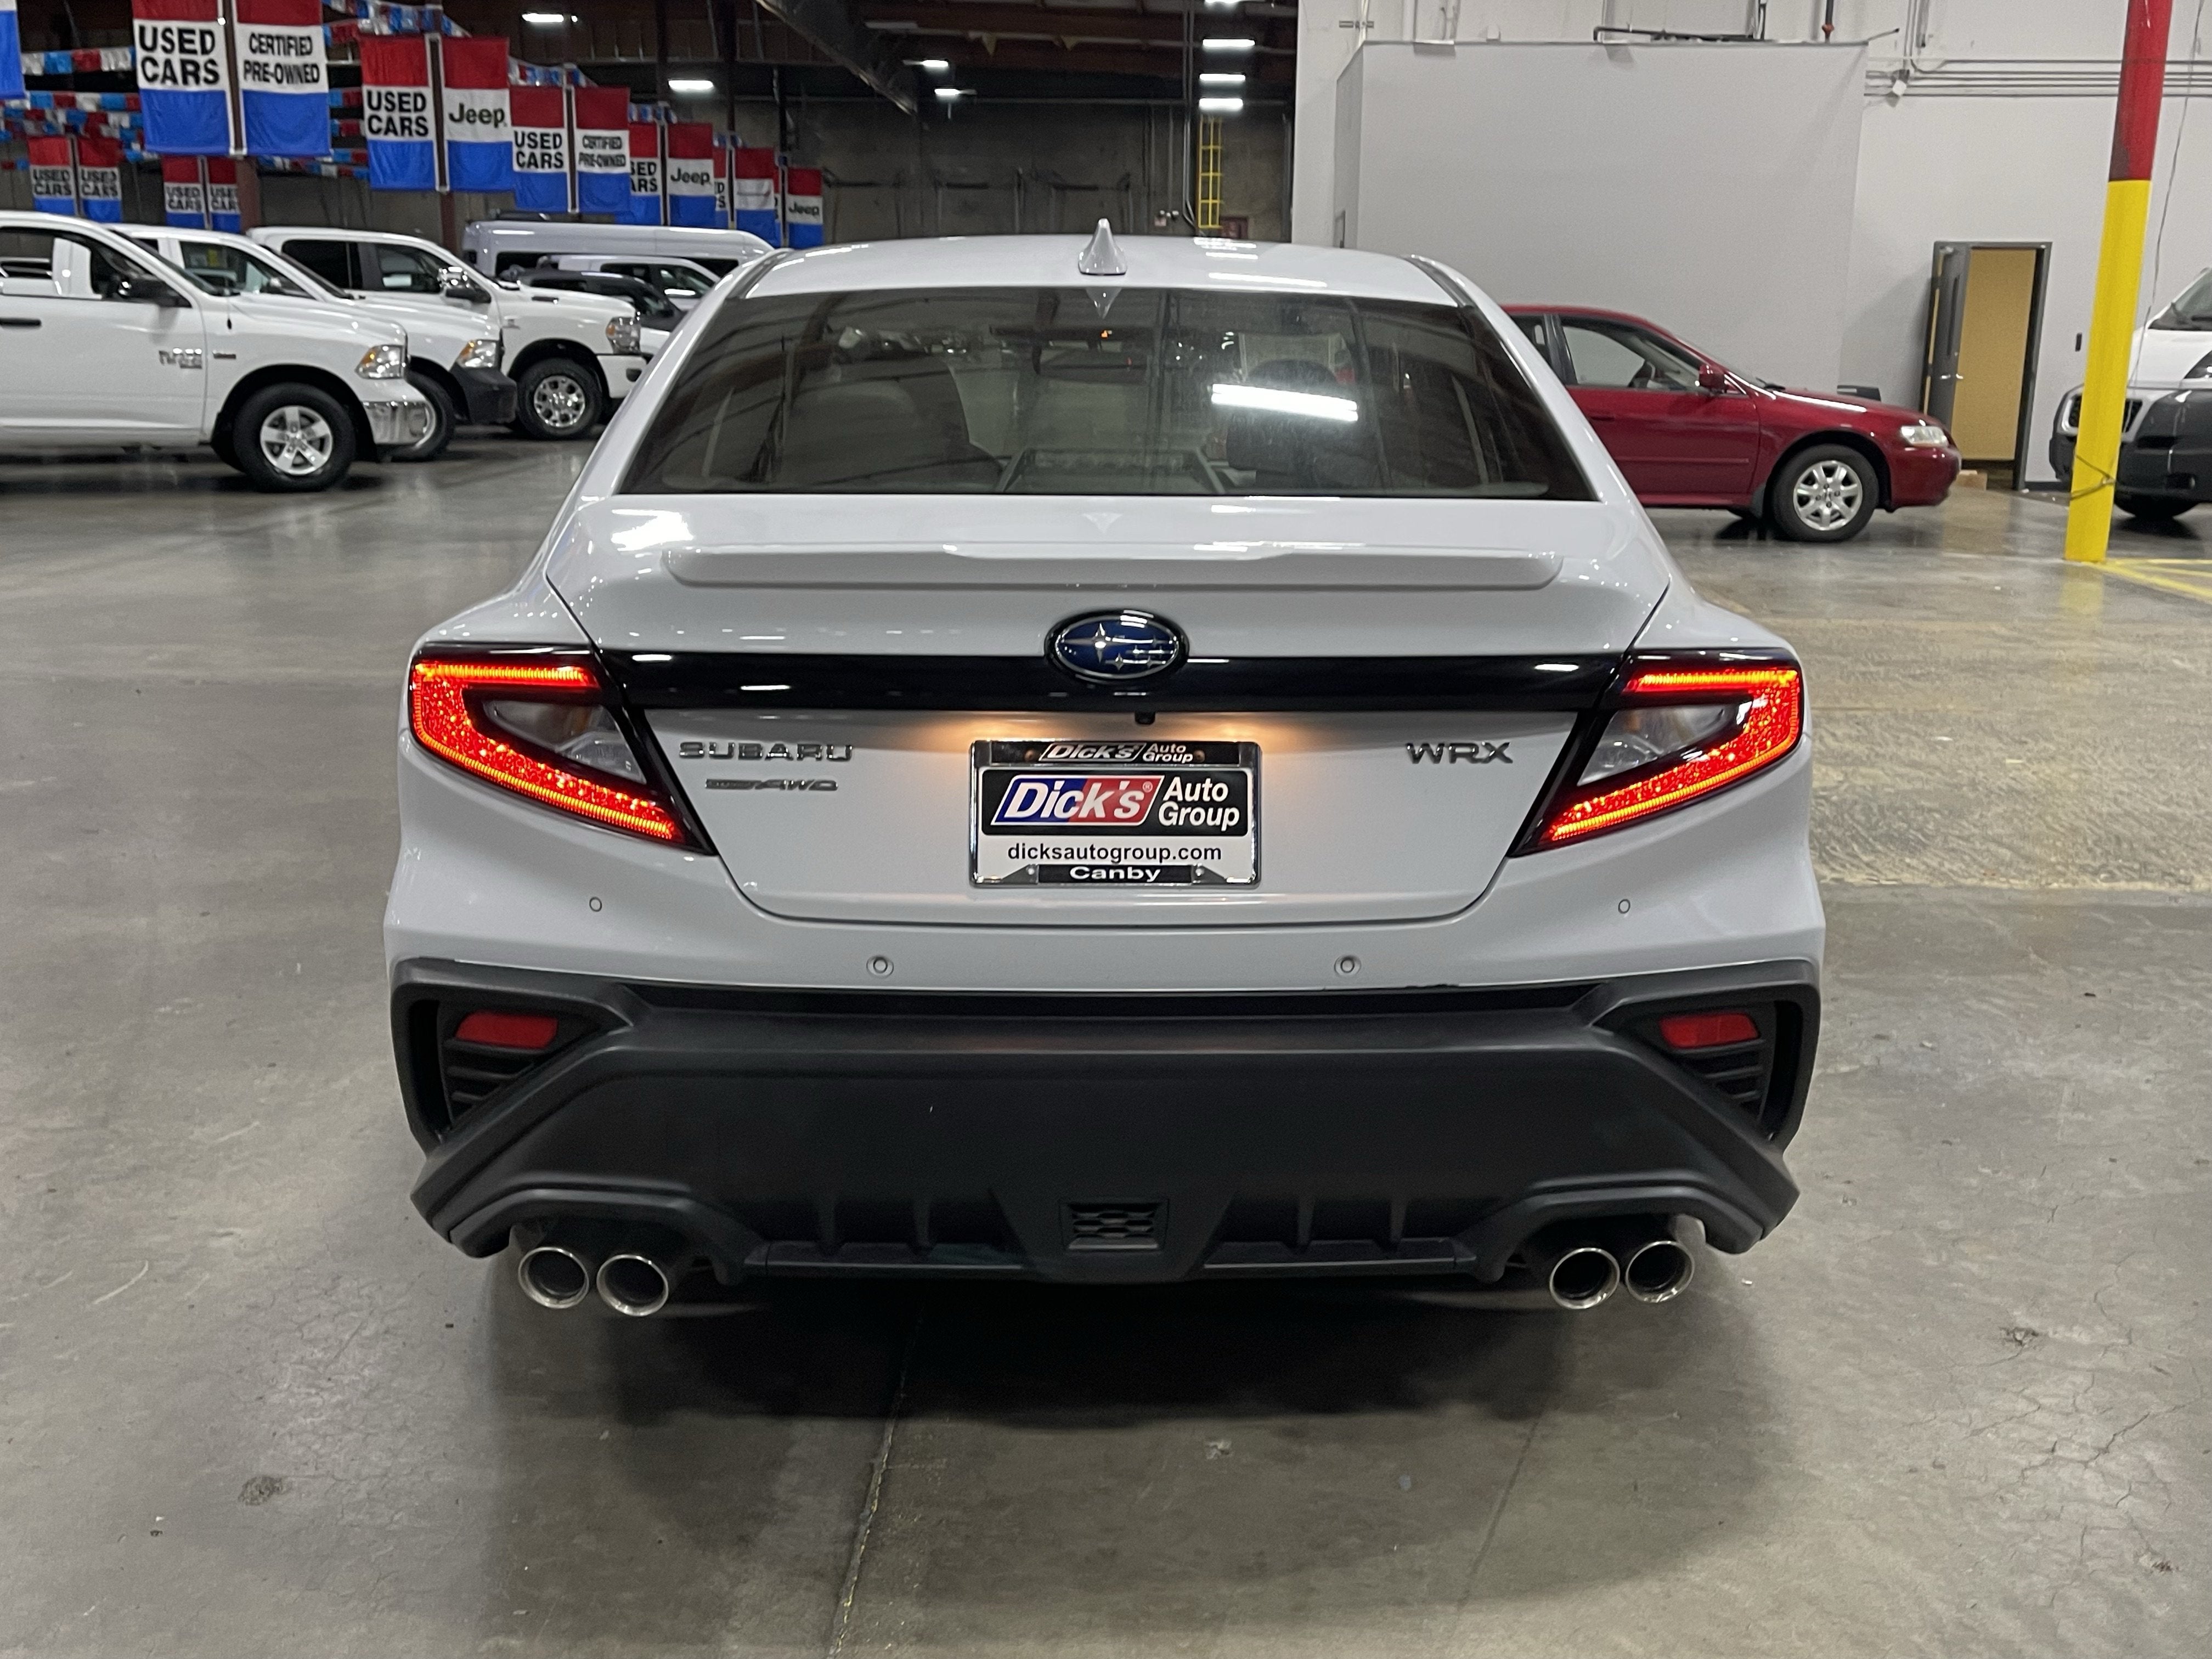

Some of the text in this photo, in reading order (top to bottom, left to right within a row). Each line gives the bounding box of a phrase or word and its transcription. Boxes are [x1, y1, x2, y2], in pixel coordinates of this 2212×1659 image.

[138, 25, 216, 55] USED
[249, 31, 313, 57] CERTIFIED
[140, 56, 220, 86] CARS
[243, 59, 320, 84] PRE-OWNED
[366, 89, 427, 113] USED
[448, 102, 505, 128] Jeep
[368, 114, 429, 137] CARS
[514, 130, 562, 150] USED
[516, 151, 564, 168] CARS
[630, 161, 657, 176] SED
[33, 168, 70, 182] USED
[630, 177, 658, 192] ARS
[670, 167, 710, 185] Jeep
[35, 182, 72, 195] CARS
[211, 198, 238, 210] CAR
[788, 202, 820, 216] Jeep
[679, 742, 853, 761] SUBARU
[1047, 743, 1136, 759] Dick's
[1147, 743, 1187, 753] Auto
[1405, 742, 1514, 764] WRX
[1142, 752, 1193, 764] Group
[1163, 776, 1229, 803] Auto
[1003, 780, 1145, 819] Dick's
[1158, 802, 1240, 831] Group
[1007, 842, 1222, 864] dicksautogroup.com
[1069, 866, 1161, 883] Canby
